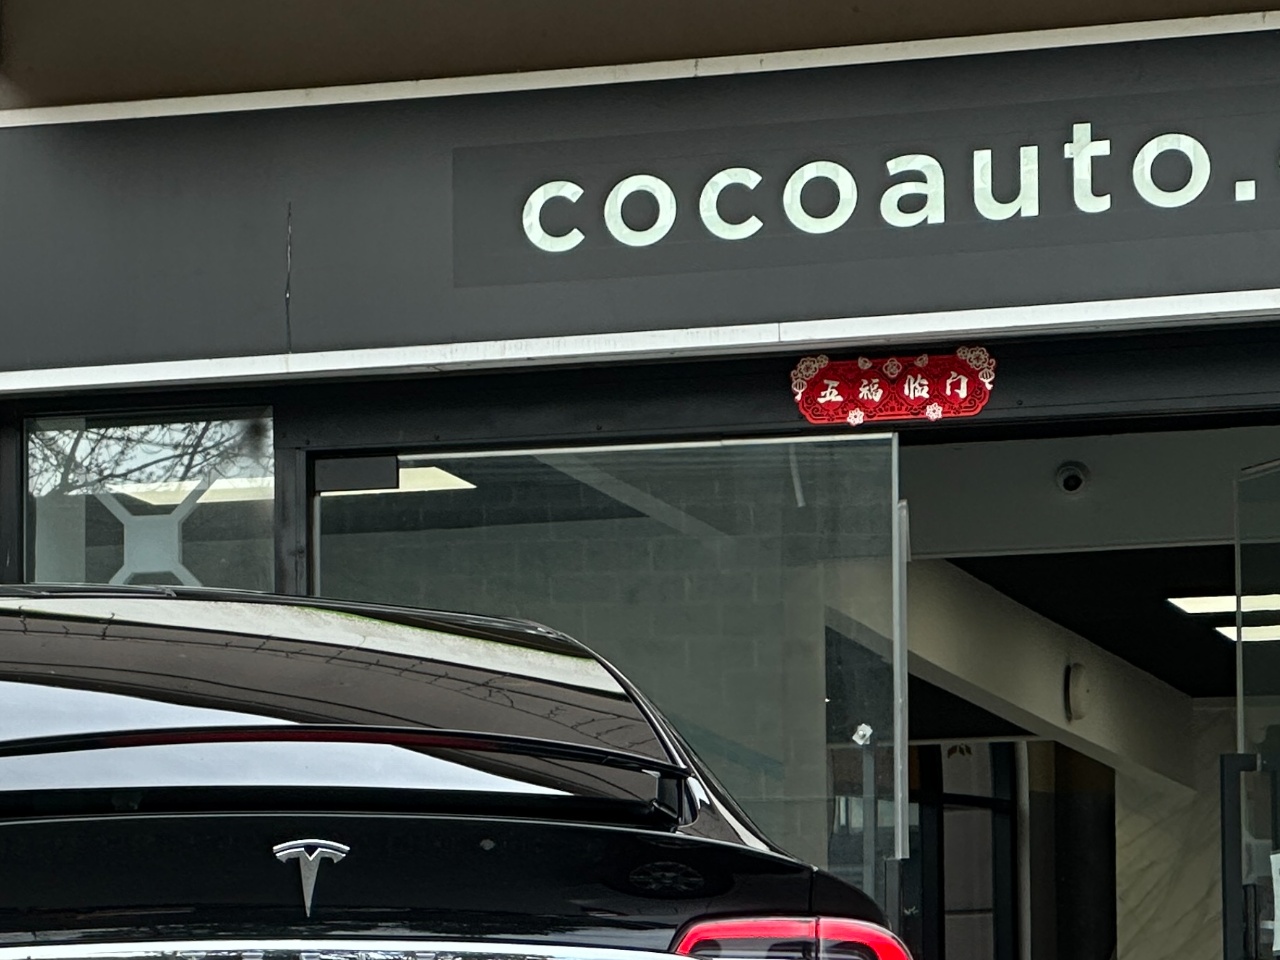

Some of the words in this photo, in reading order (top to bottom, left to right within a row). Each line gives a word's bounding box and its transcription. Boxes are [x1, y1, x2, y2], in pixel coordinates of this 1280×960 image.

[522, 122, 1280, 253] cocoauto.
[816, 371, 970, 404] 五福临门
